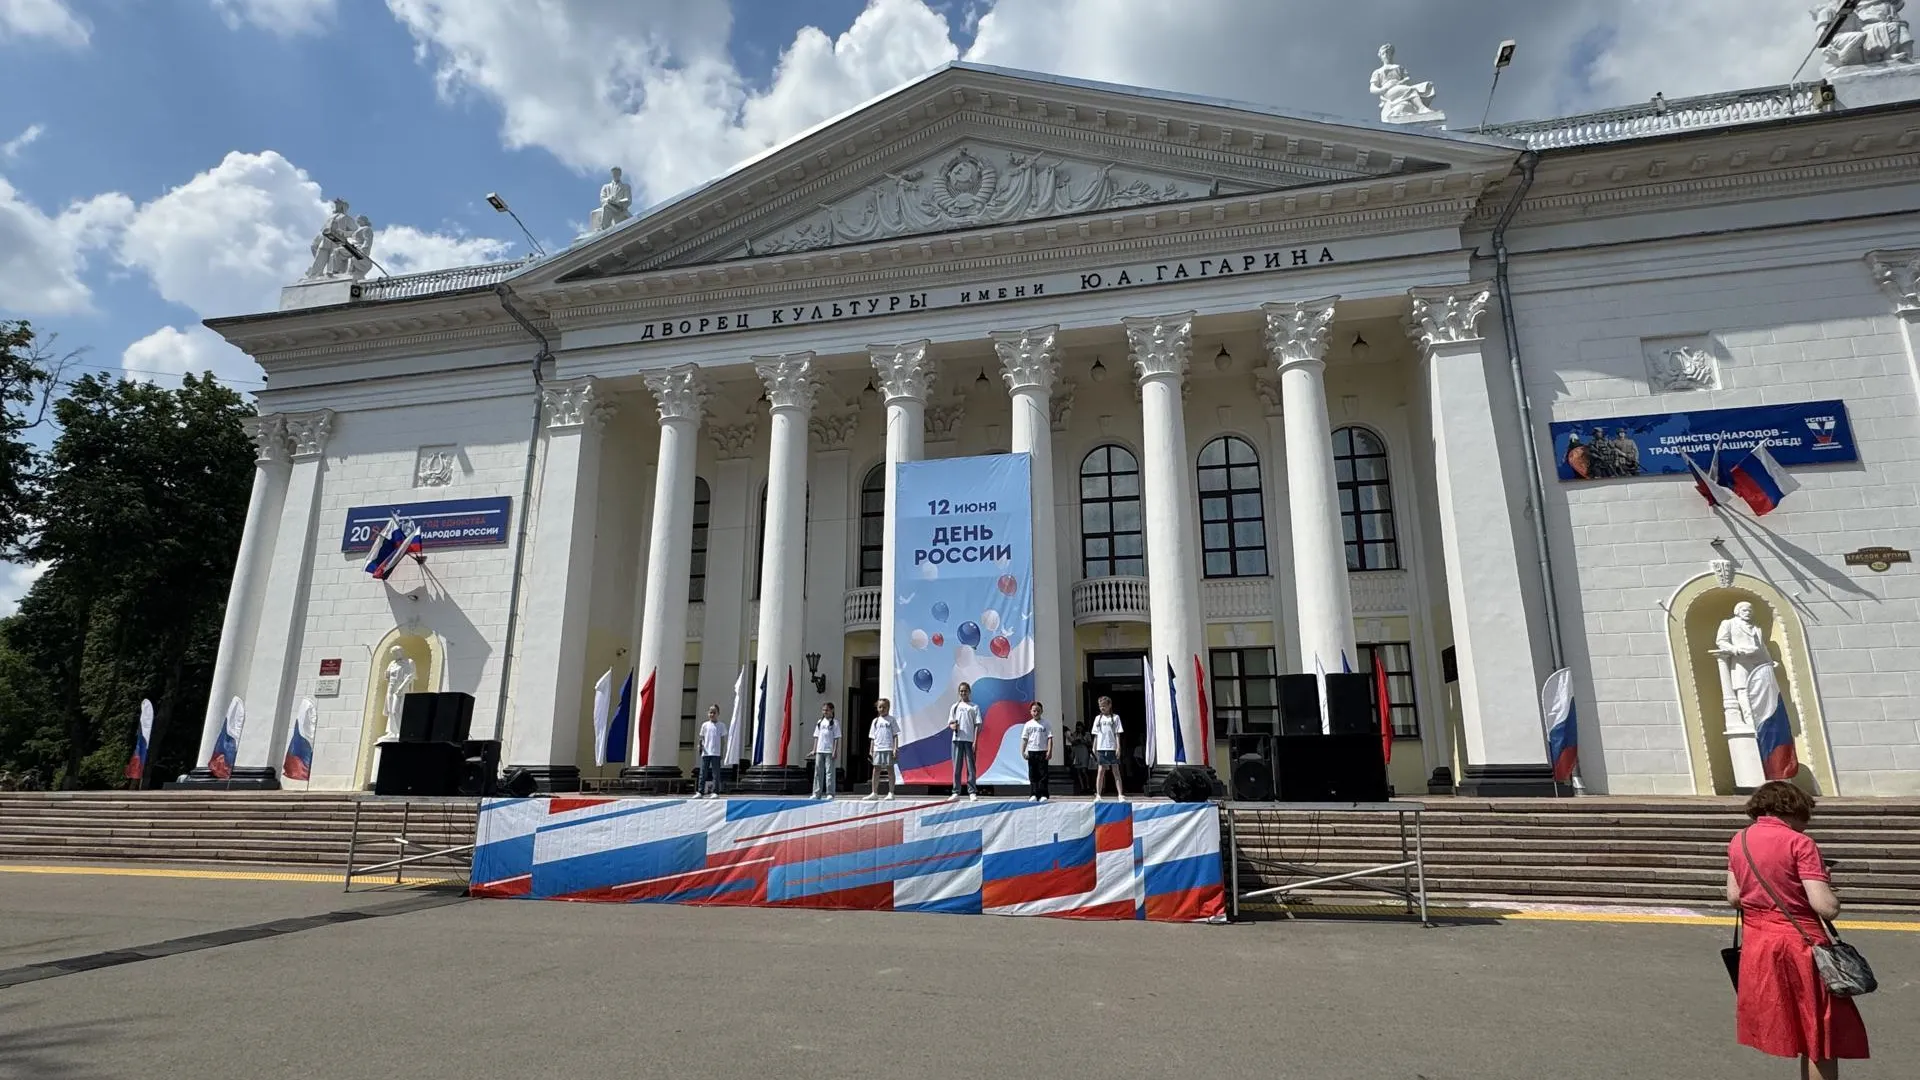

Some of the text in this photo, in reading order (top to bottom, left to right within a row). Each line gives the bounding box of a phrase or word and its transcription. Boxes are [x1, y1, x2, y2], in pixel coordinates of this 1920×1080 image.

[641, 314, 749, 340] ДВОРЕЦ
[772, 293, 927, 324] КУЛЬТУРЫ
[960, 283, 1044, 302] ИМЕНИ
[1660, 433, 1720, 445] ЕДИНСТВО
[1724, 428, 1779, 440] НАРОДОВ
[928, 499, 950, 515] 12
[421, 526, 499, 539] НАРОДОВ РОССИИ
[932, 525, 994, 546] ДЕНЬ
[915, 544, 1011, 566] РОССИИ
